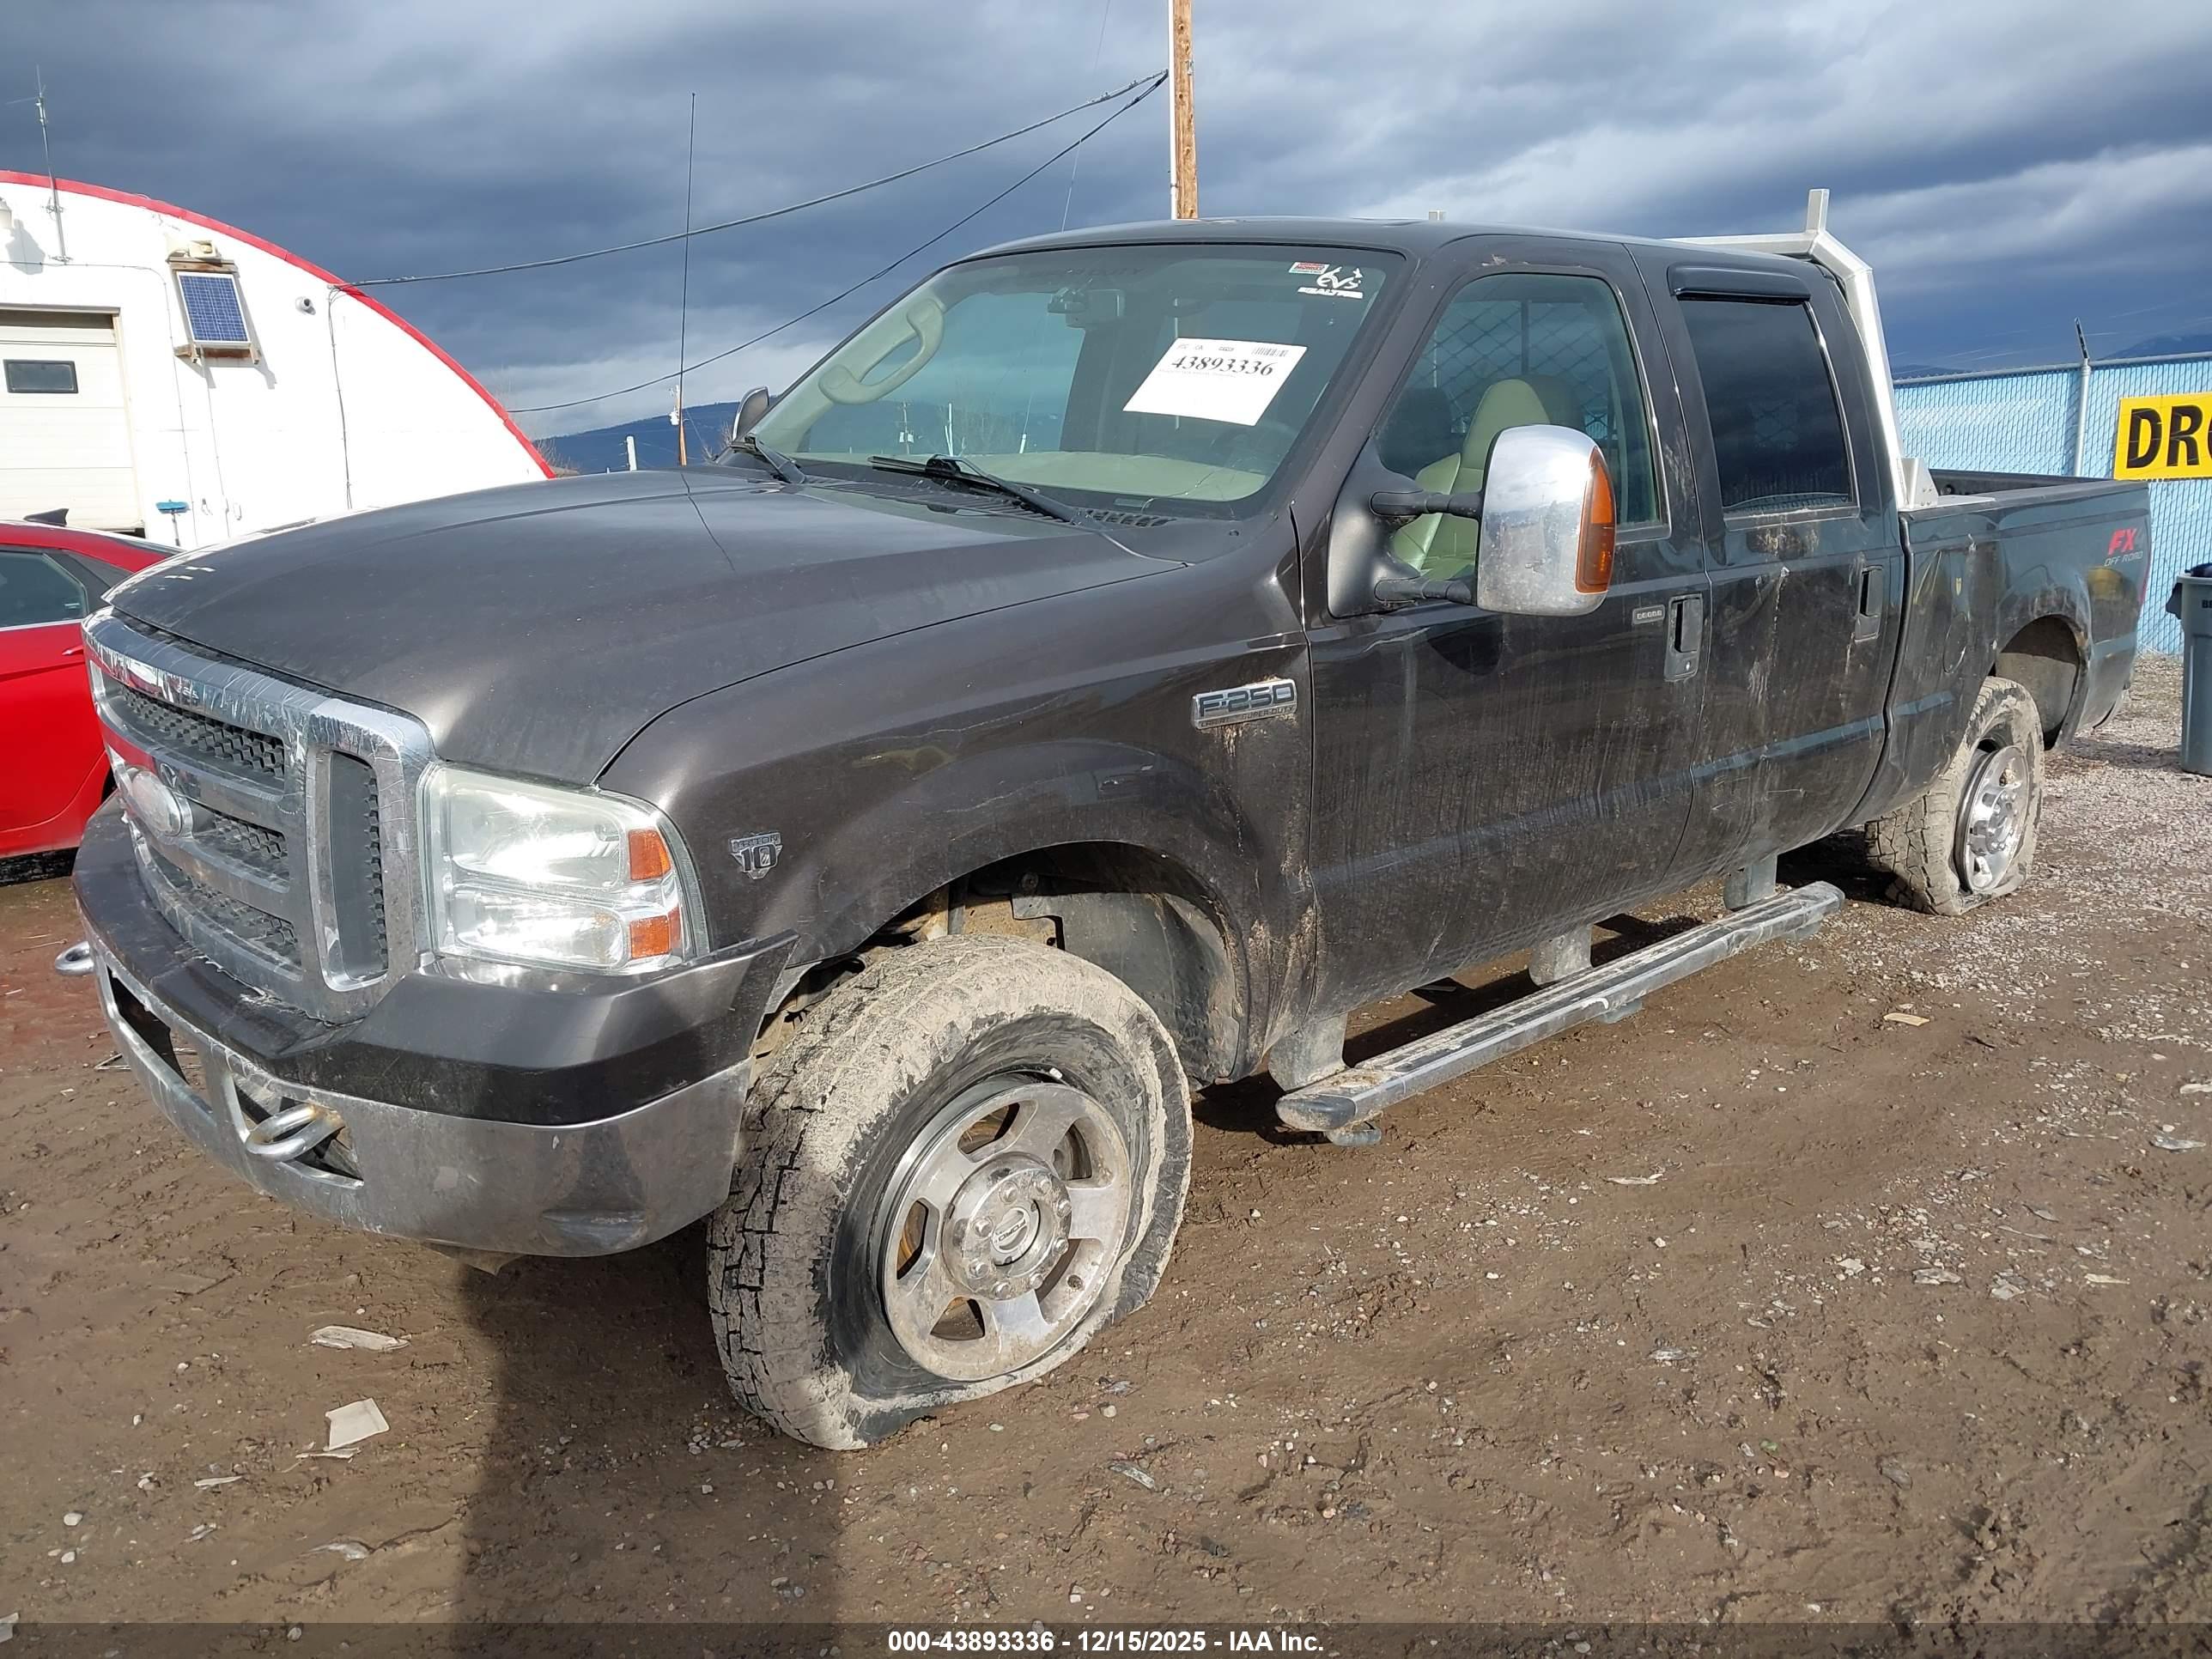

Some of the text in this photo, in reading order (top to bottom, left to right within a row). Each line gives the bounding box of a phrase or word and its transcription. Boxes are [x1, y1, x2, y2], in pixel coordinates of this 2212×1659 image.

[1171, 355, 1279, 377] 43893336
[2126, 404, 2212, 470] DR
[1199, 682, 1295, 717] F-250
